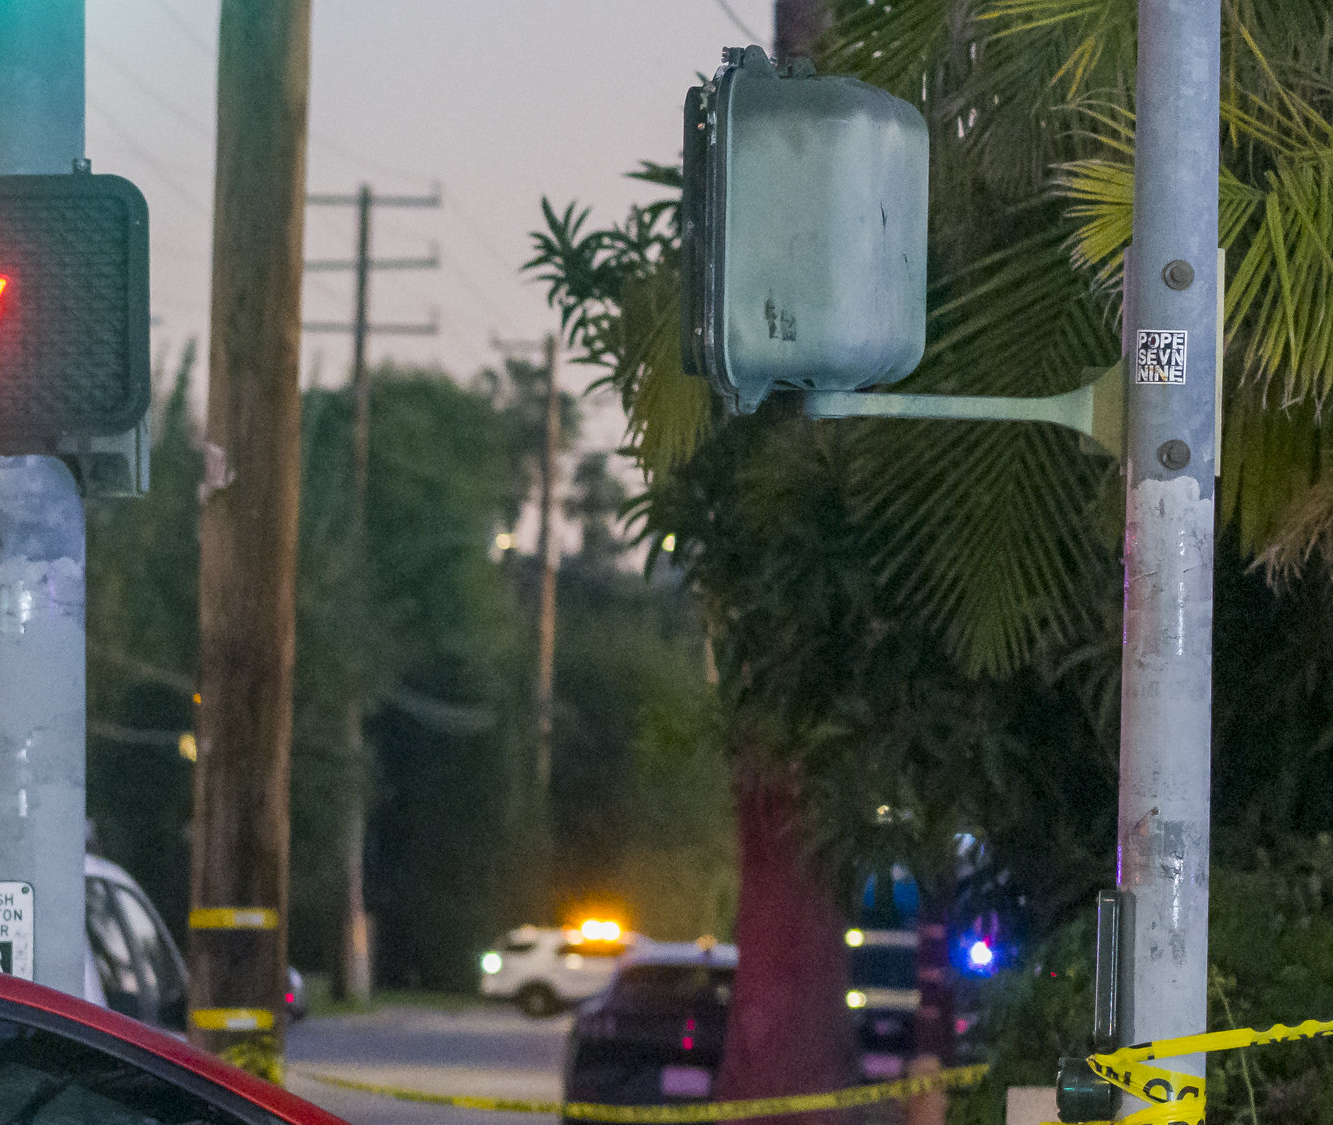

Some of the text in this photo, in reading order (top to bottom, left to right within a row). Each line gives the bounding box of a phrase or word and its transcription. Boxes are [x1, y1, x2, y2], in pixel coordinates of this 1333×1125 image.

[1138, 332, 1184, 349] POPE
[1138, 348, 1184, 366] SEVN
[1137, 365, 1183, 382] NINE
